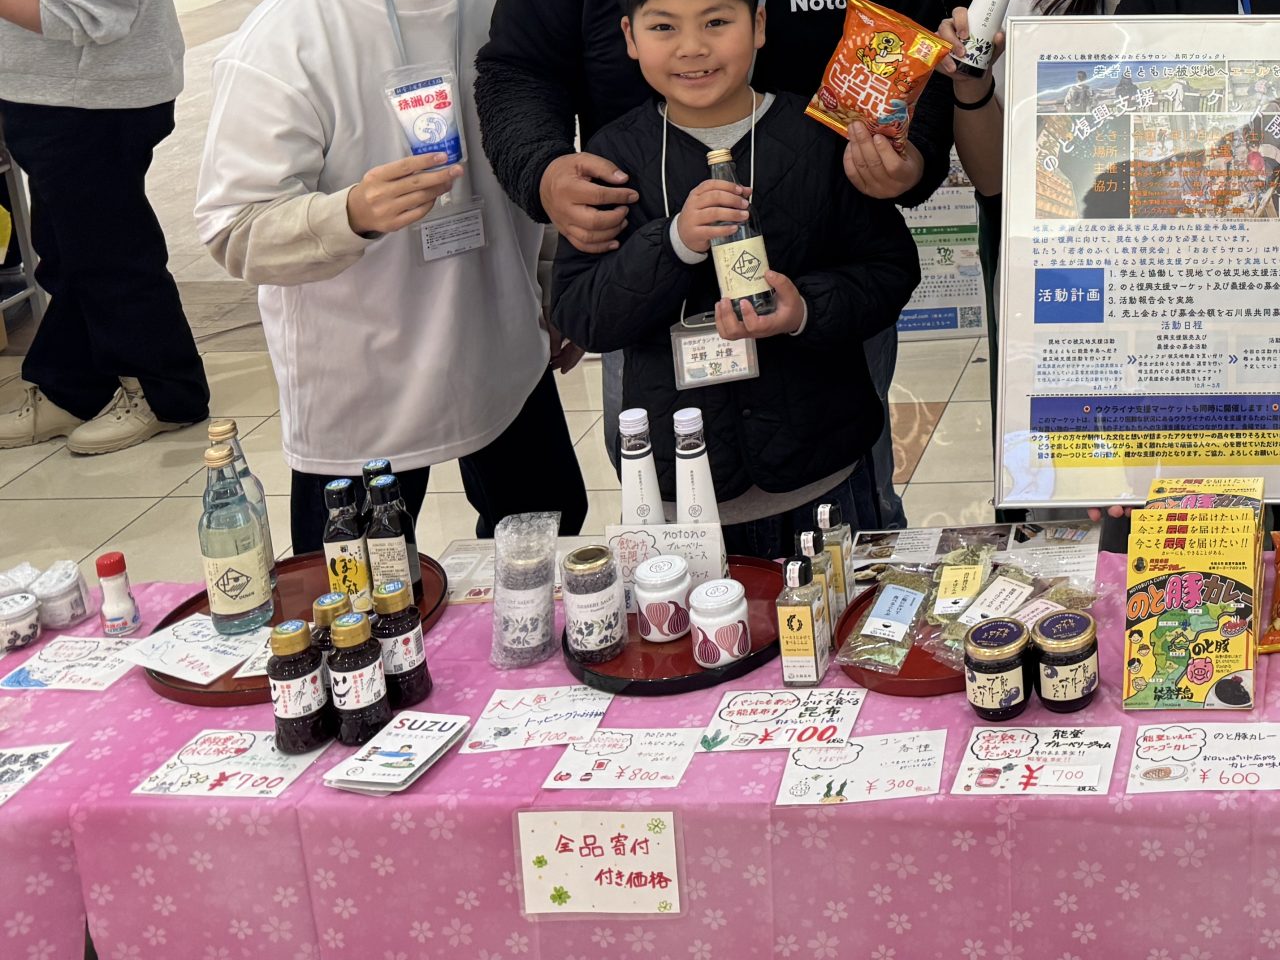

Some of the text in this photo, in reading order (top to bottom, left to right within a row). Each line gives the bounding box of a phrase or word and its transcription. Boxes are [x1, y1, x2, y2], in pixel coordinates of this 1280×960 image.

[1038, 288, 1100, 303] 活動計画
[1119, 295, 1195, 306] 活動報告会を実施
[1161, 319, 1203, 331] 活動日程
[662, 529, 707, 541] notono
[1127, 572, 1253, 621] のと豚カレー
[1192, 639, 1230, 655] のと豚
[799, 706, 841, 718] 昆布
[393, 717, 458, 733] SUZU
[1214, 731, 1278, 741] のと豚カレー
[1142, 742, 1199, 753] ゴーゴーカレー
[615, 765, 660, 781] ¥800
[208, 771, 284, 791] ¥700
[595, 868, 672, 890] 付き価格
